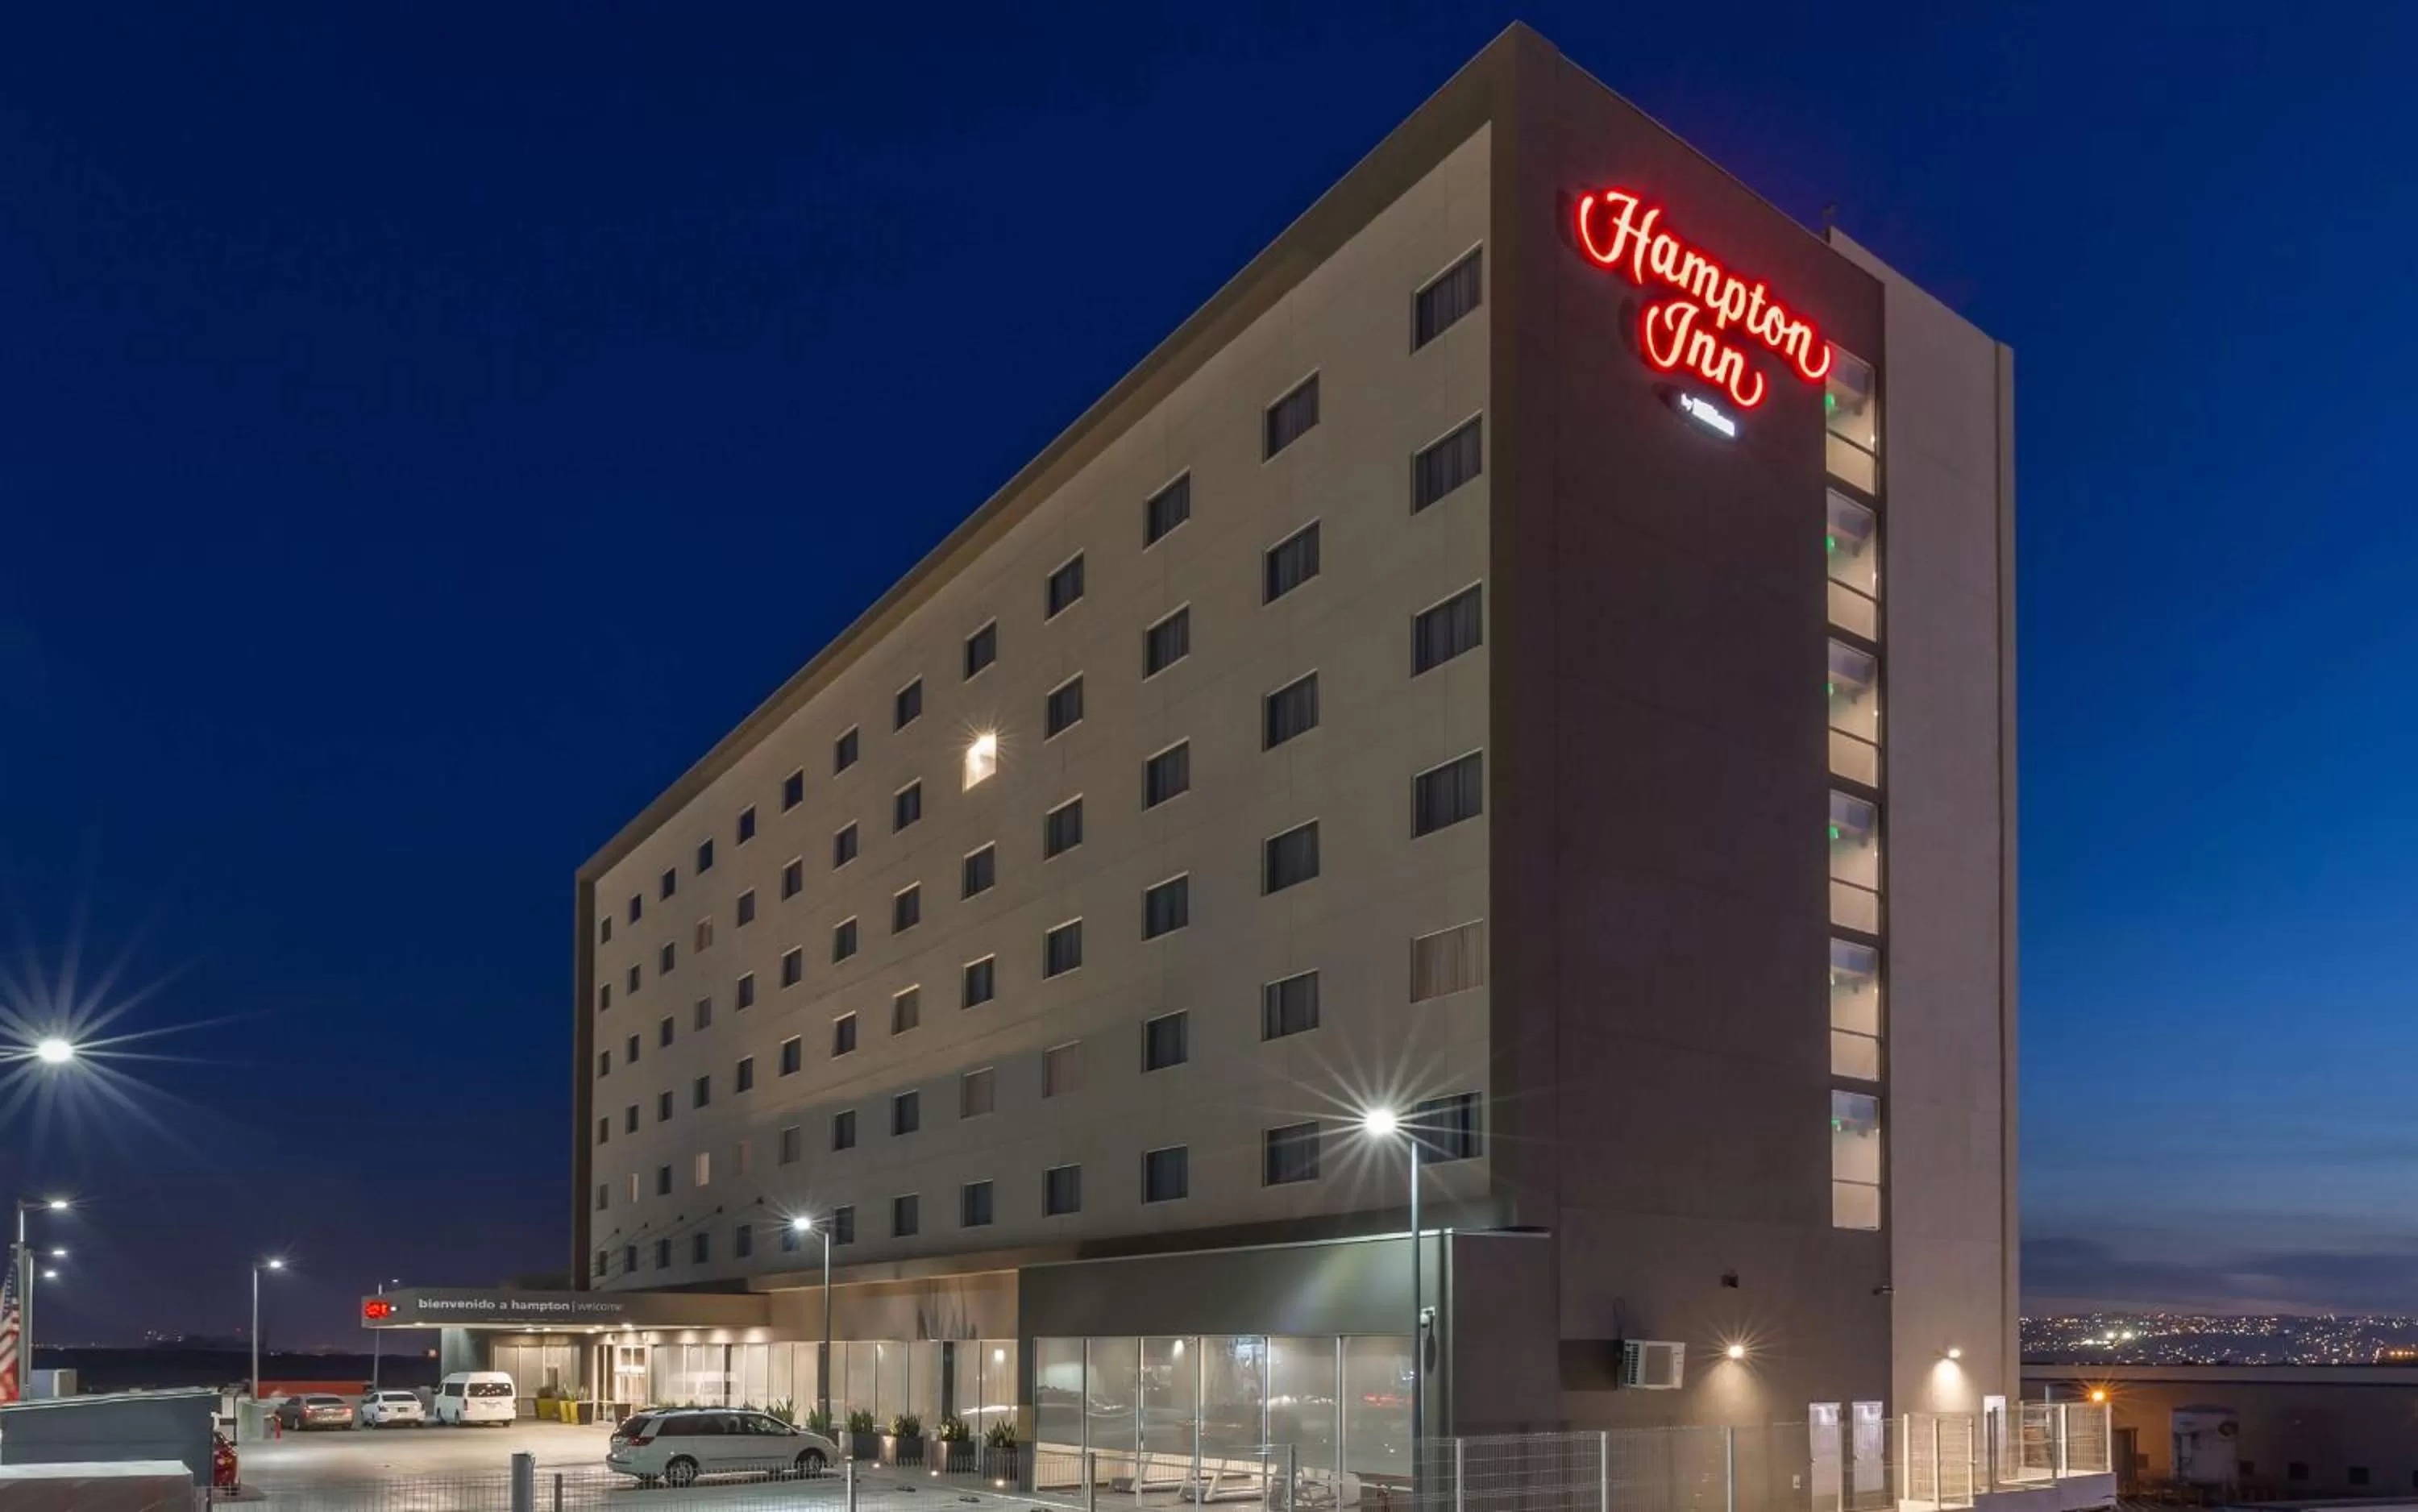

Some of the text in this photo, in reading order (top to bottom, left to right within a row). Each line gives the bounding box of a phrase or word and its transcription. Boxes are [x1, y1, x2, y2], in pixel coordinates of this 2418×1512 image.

[1579, 190, 1830, 378] Hampton
[1645, 301, 1764, 406] Inn
[418, 1298, 496, 1310] bienvenido
[499, 1302, 508, 1310] a
[511, 1299, 570, 1311] hampton
